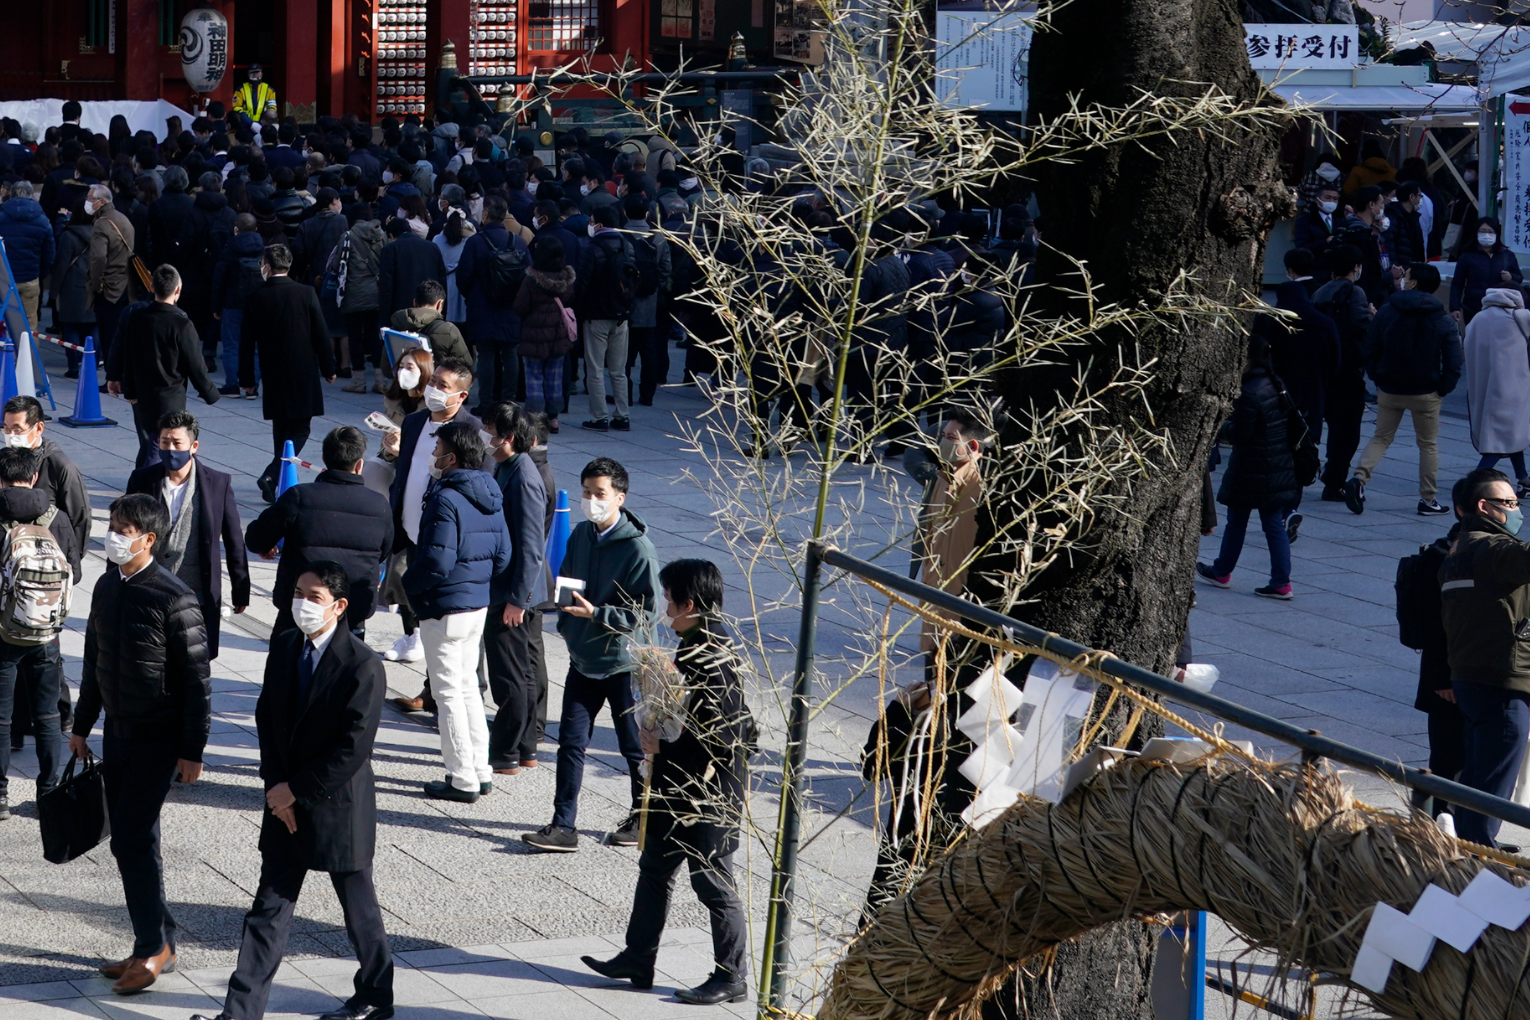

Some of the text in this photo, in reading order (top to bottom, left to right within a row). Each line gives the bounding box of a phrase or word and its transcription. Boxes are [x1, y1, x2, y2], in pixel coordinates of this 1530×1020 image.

[204, 21, 227, 82] 神田明神
[1247, 34, 1352, 59] 参拝受付
